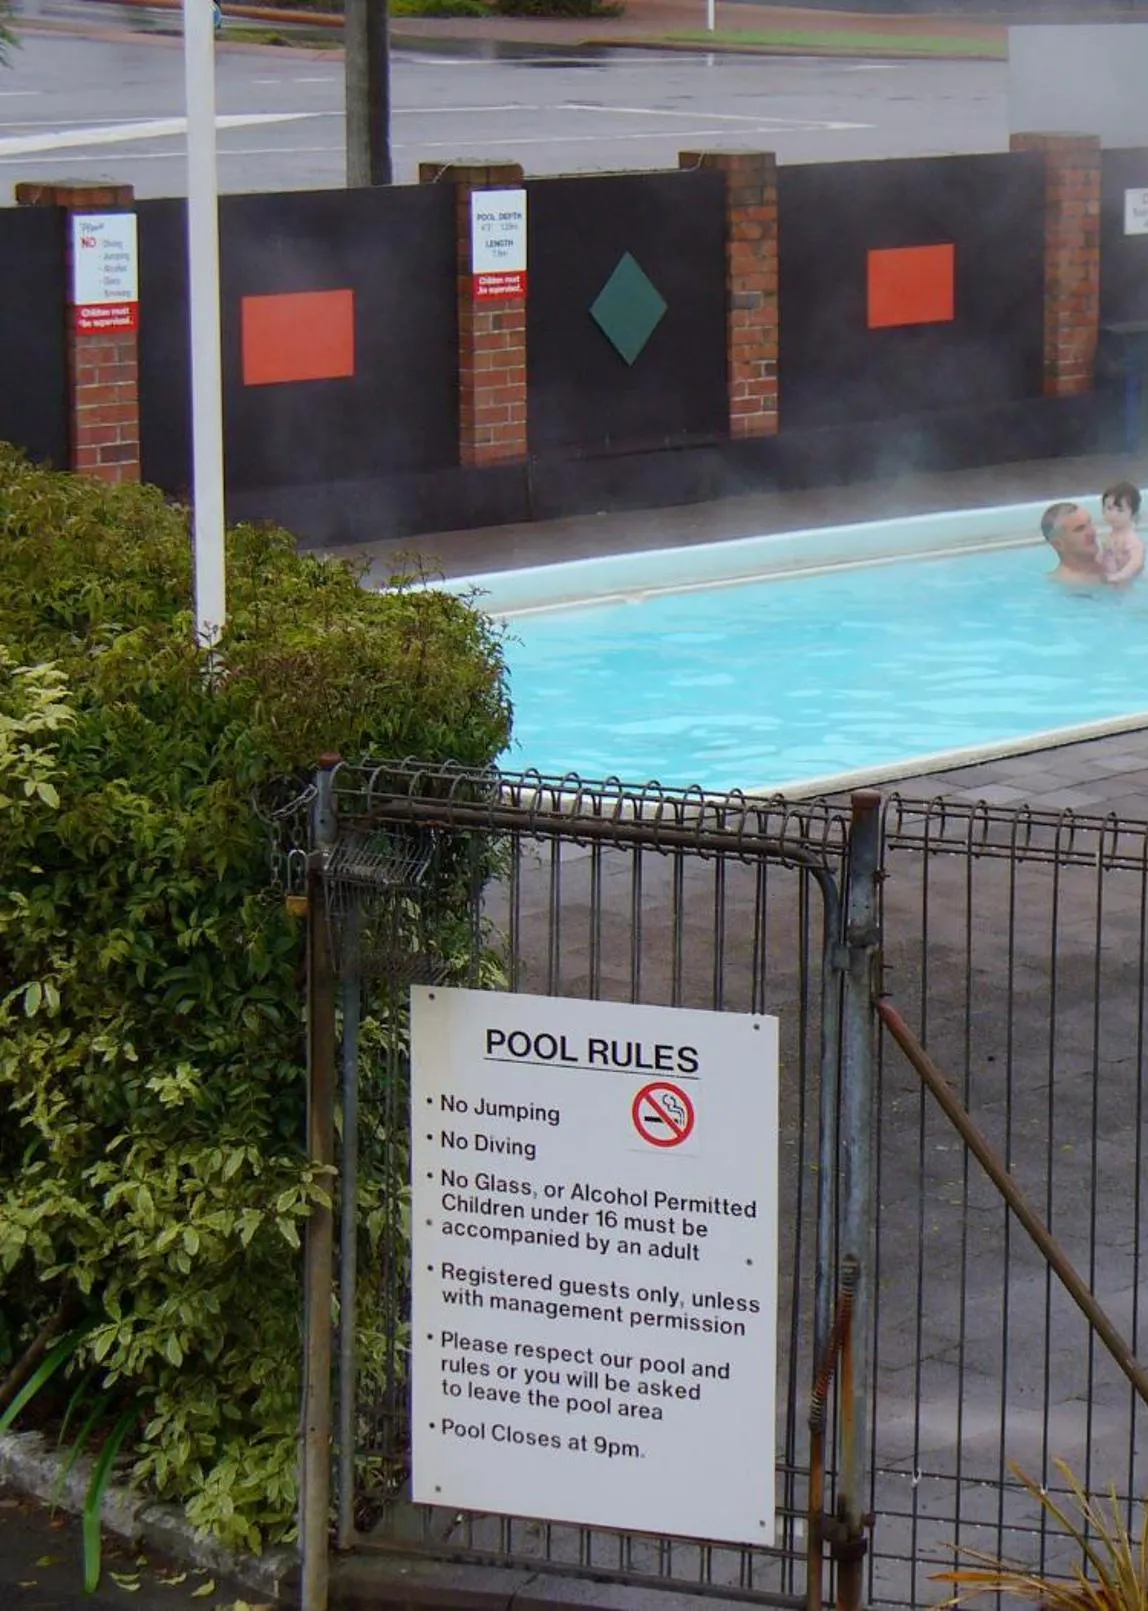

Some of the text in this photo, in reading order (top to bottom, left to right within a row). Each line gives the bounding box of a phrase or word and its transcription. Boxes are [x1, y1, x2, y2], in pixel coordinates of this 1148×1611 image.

[477, 212, 522, 221] POOL DEPTH
[81, 236, 96, 248] NO
[485, 240, 514, 248] LENGTH
[487, 1029, 699, 1074] POOL RULES
[441, 1095, 560, 1126] No Jumping
[442, 1131, 536, 1160] No Diving
[442, 1170, 756, 1218] No Glass, or Alcohol Permitted
[442, 1195, 708, 1238] Children under 16 must be
[442, 1219, 699, 1261] accompanied by an adult
[442, 1262, 760, 1314] Registered guests only, unless
[442, 1289, 746, 1336] with management permission
[442, 1332, 730, 1380] Please respect our pool and
[441, 1357, 701, 1401] rules or you will be asked
[443, 1380, 663, 1421] to leave the pool area
[442, 1419, 646, 1459] Pool Closes at 9pm.
